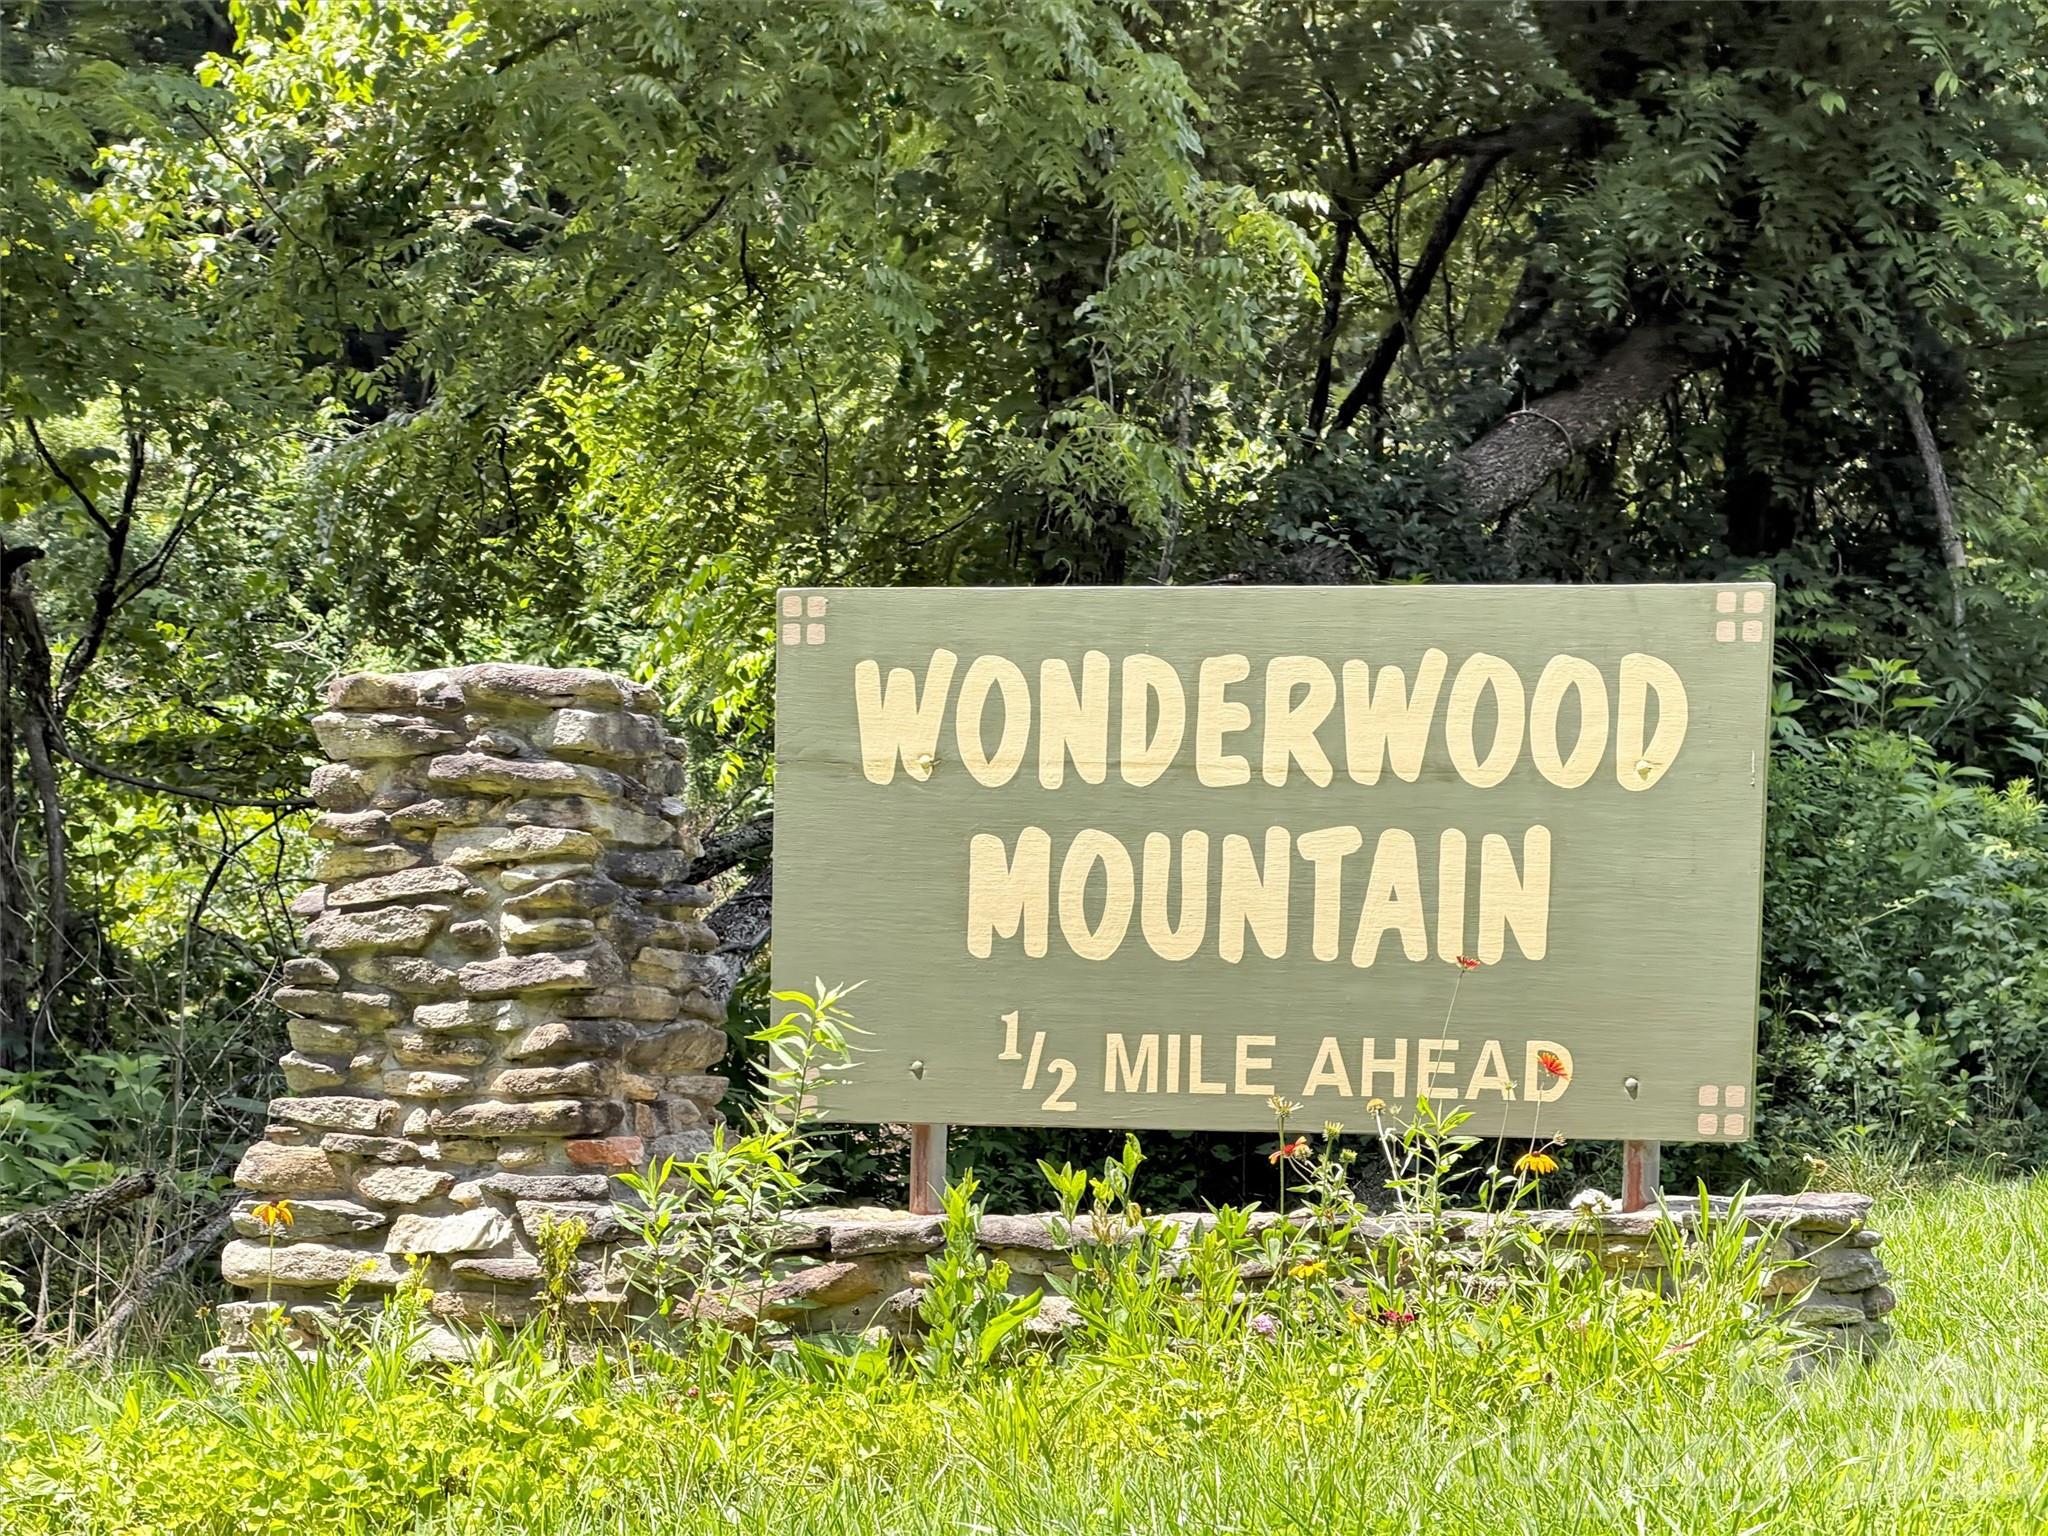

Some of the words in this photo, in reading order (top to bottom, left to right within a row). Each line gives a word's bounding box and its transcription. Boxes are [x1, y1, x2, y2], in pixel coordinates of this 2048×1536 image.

[854, 648, 1690, 792] WONDERWOOD
[966, 824, 1553, 968] MOUNTAIN
[1104, 1032, 1278, 1096] MILE
[1303, 1036, 1574, 1103] AHEAD
